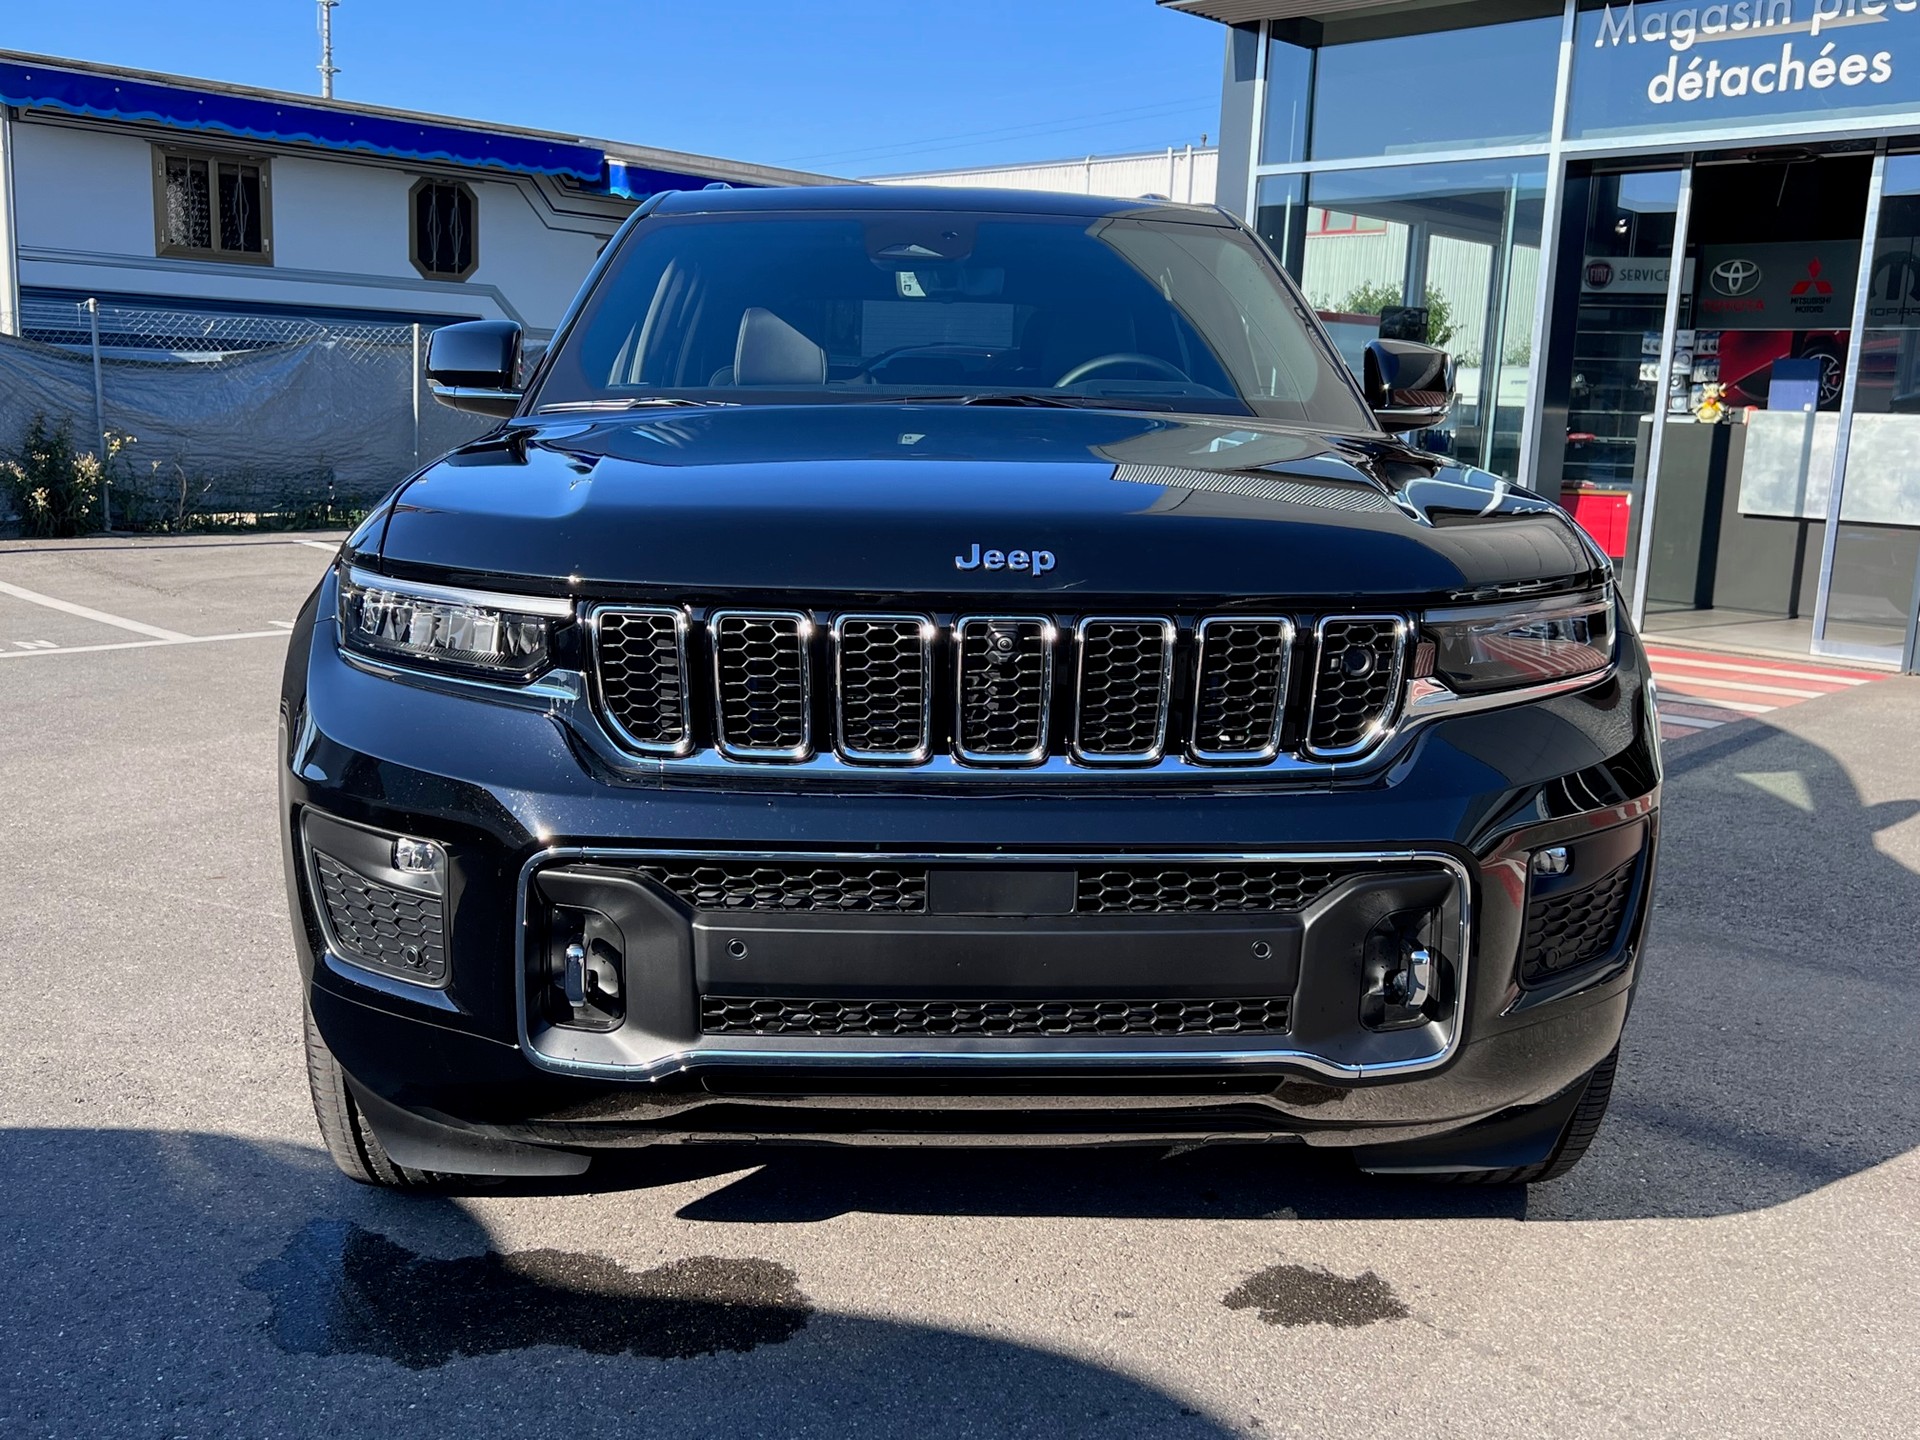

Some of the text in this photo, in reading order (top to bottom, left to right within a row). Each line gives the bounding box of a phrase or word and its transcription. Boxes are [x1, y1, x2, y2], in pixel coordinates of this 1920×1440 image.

[1594, 0, 1791, 51] Magasin
[1648, 42, 1892, 104] détachées
[1590, 268, 1609, 282] FIAT
[1703, 298, 1765, 312] TOYOTA
[1791, 296, 1832, 304] MITSUBISHI
[1795, 305, 1824, 313] MOTORS
[1870, 307, 1920, 317] OPAR
[955, 543, 1056, 575] Jeep
